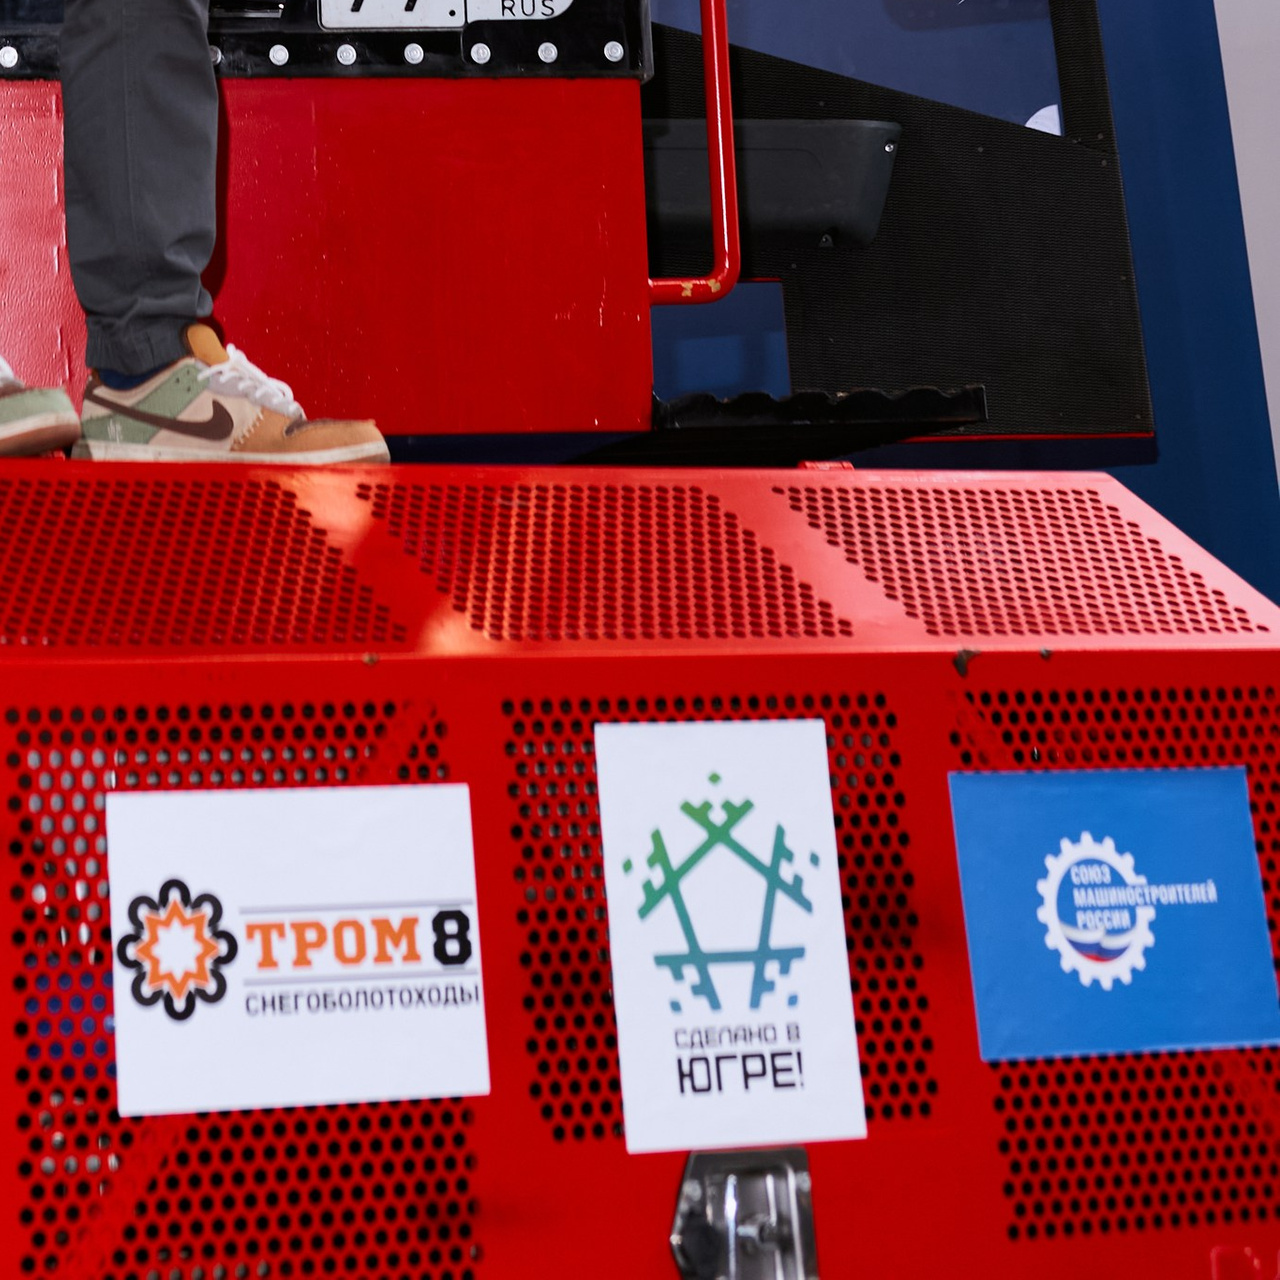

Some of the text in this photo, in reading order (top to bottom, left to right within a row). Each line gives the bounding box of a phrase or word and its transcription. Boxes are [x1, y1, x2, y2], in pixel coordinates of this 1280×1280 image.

[1070, 863, 1112, 886] СОЮЗ
[1073, 879, 1218, 908] МАШИНОСТРОИТЕЛЕЙ
[1075, 908, 1132, 931] РОССИИ
[245, 909, 473, 970] ТРОМ 8
[245, 983, 480, 1017] СНЕГОБОЛОТОХОДЫ
[674, 1022, 801, 1050] СДЕЛАНО В
[676, 1050, 804, 1096] ЮГРЕ!
